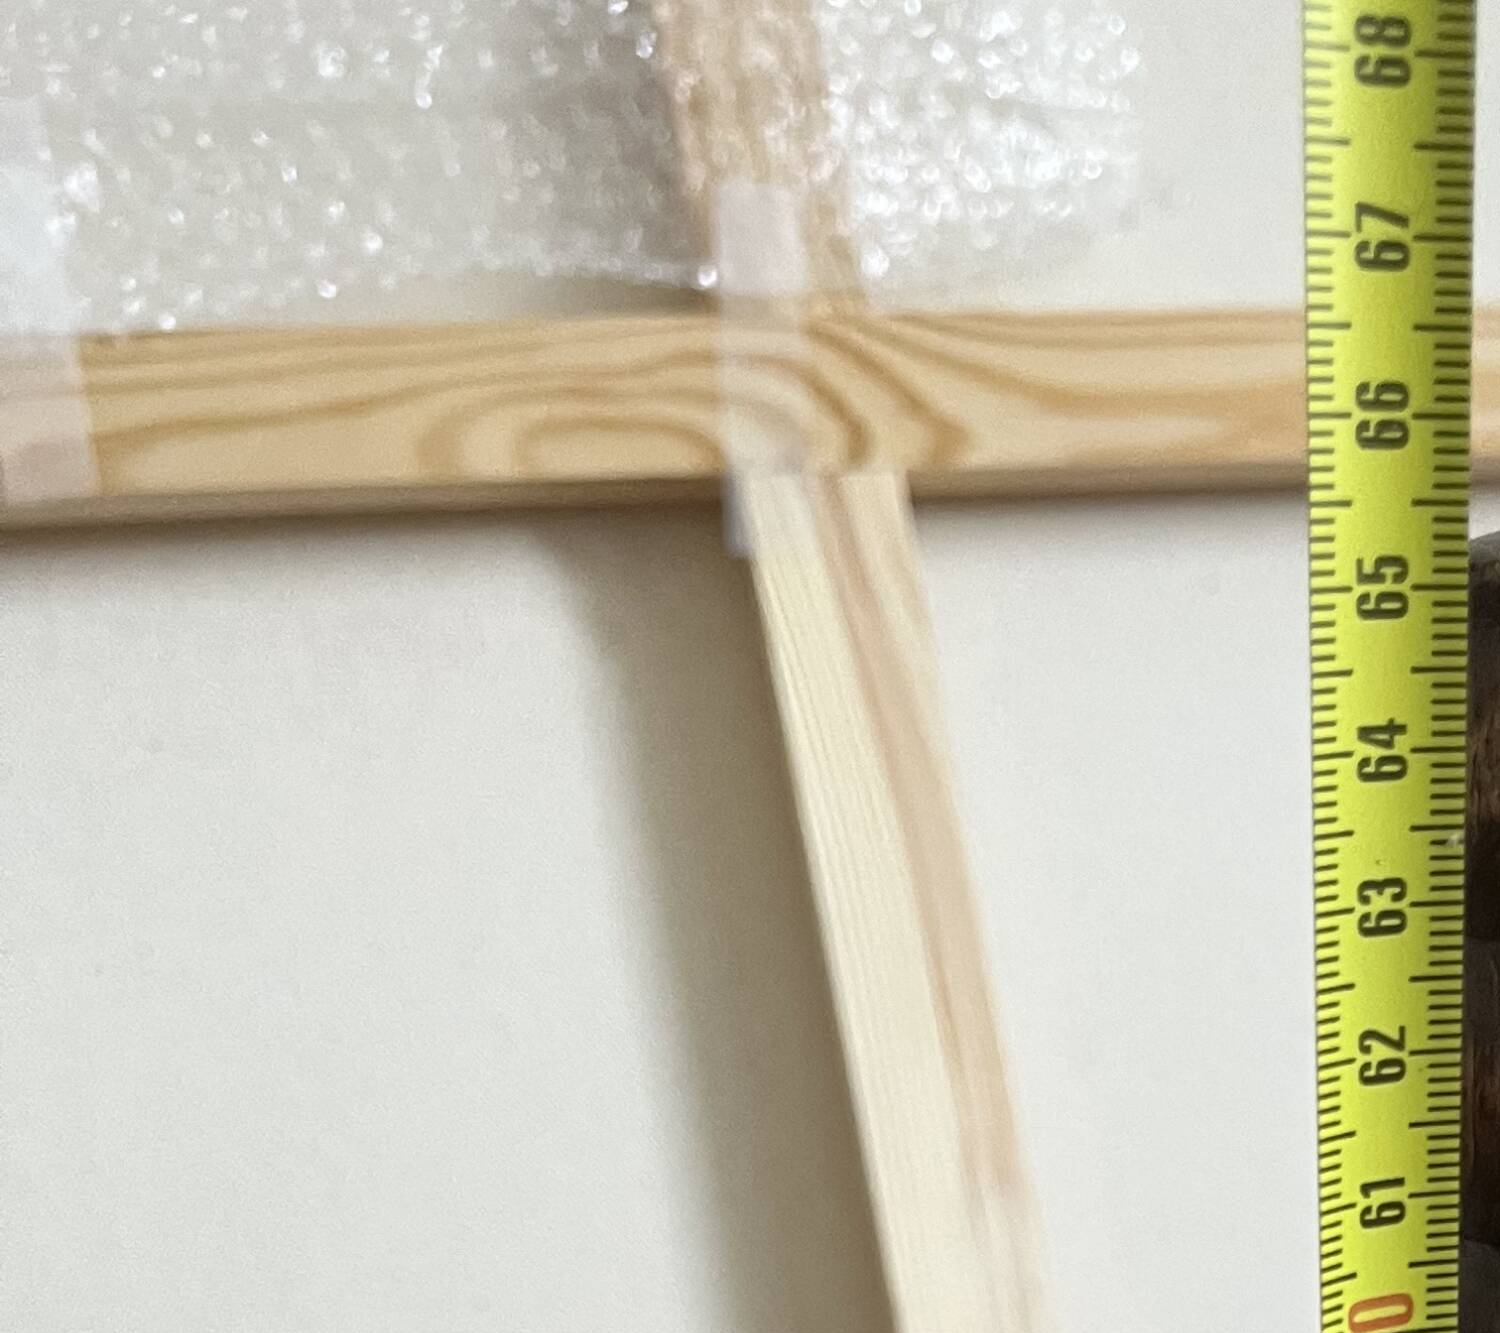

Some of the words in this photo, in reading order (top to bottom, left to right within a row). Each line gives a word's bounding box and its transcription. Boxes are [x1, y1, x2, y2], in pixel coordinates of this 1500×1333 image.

[1354, 14, 1412, 88] 68
[1355, 201, 1410, 272] 67
[1355, 380, 1410, 450] 66
[1356, 554, 1409, 620] 65
[1357, 717, 1408, 783] 64
[1357, 876, 1407, 937] 63
[1358, 1025, 1407, 1087] 62
[1359, 1176, 1406, 1230] 61
